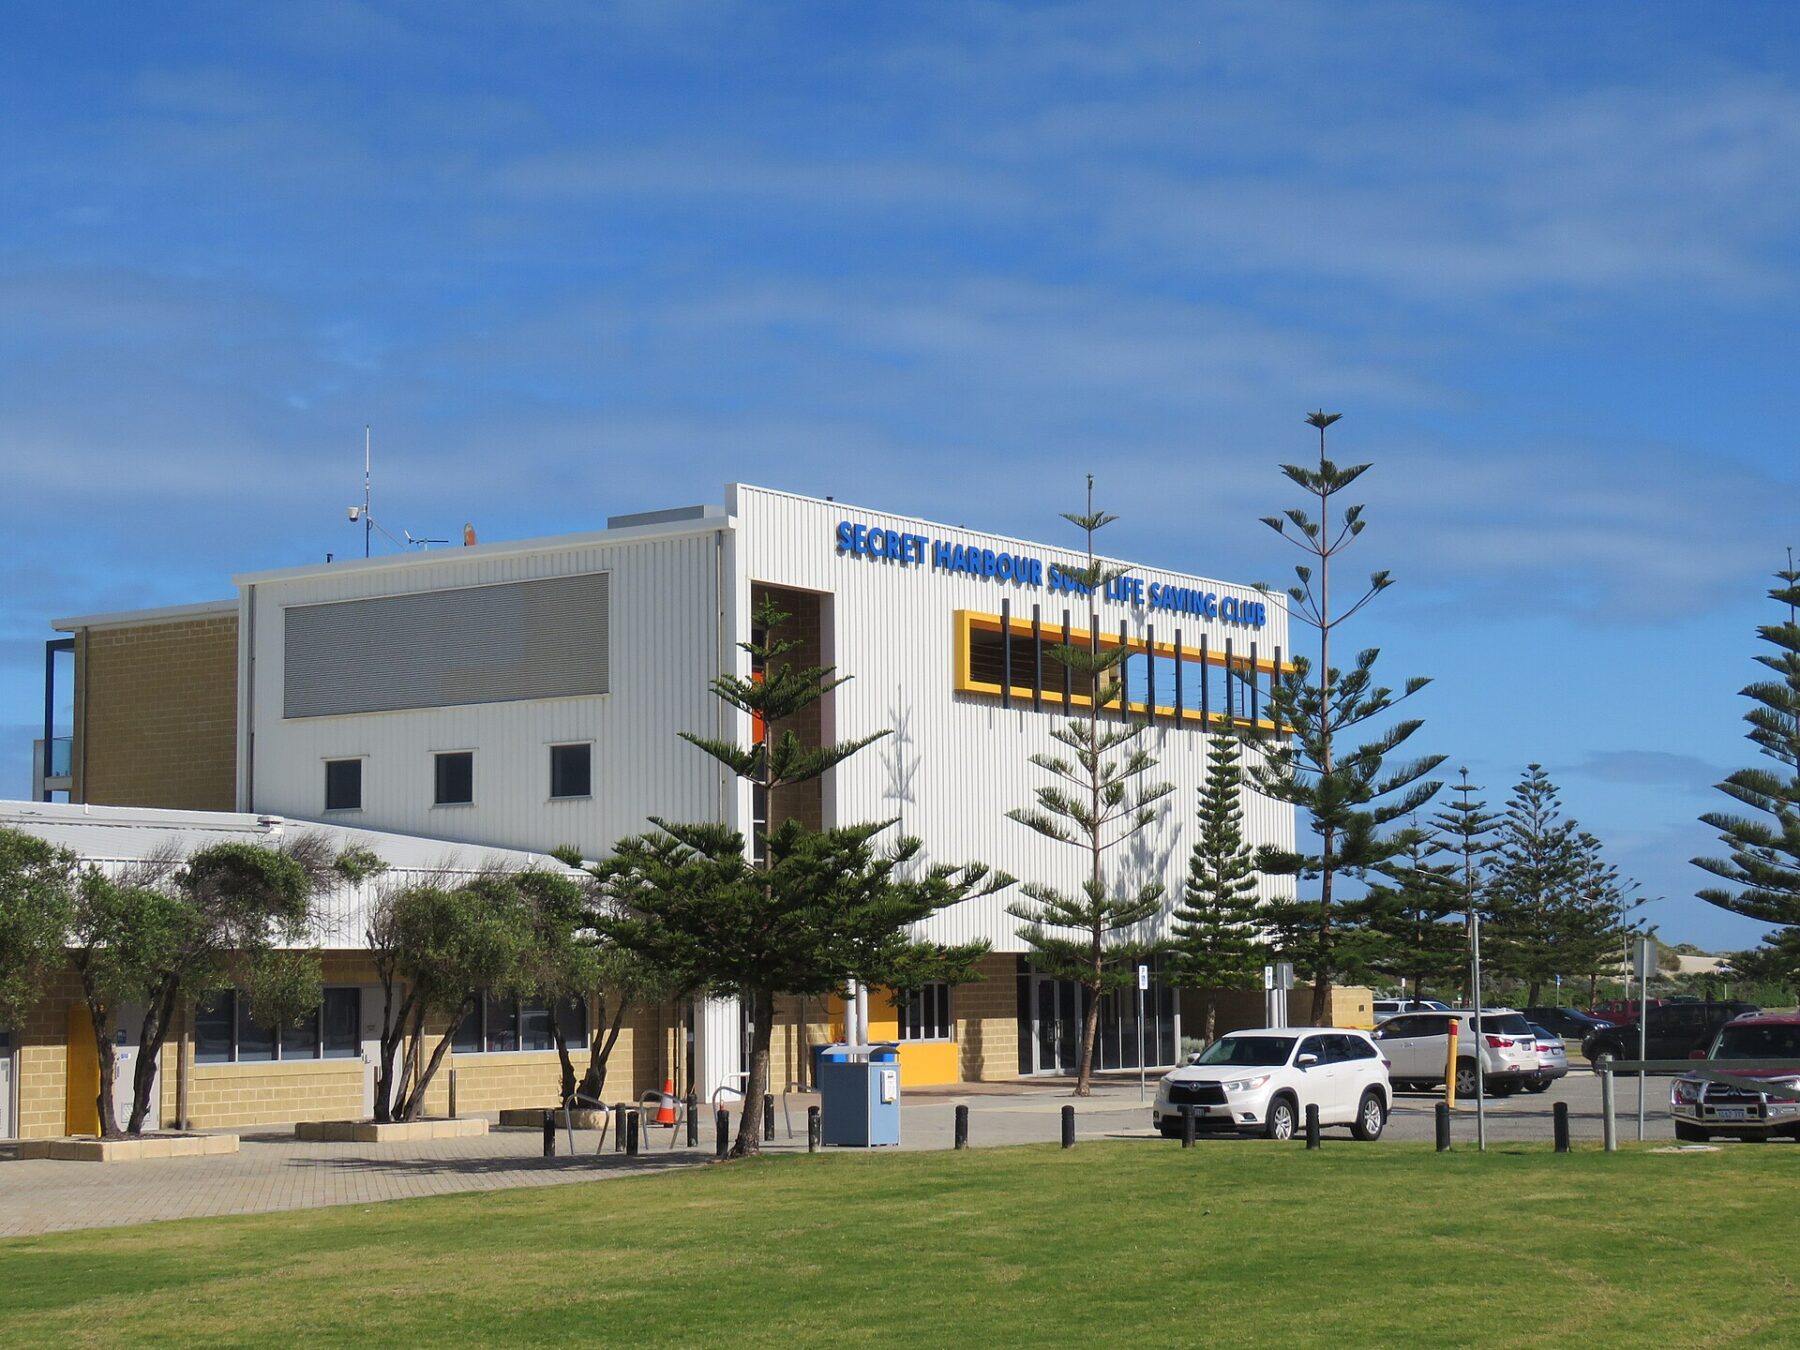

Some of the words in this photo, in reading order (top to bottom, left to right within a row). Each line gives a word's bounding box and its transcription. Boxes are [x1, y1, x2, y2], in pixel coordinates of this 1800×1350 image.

[838, 521, 929, 564] SECRET
[934, 540, 1043, 586] HARBOUR
[1106, 574, 1145, 605] LIFE
[1150, 582, 1217, 618] SAVING
[1222, 596, 1266, 626] CLUB
